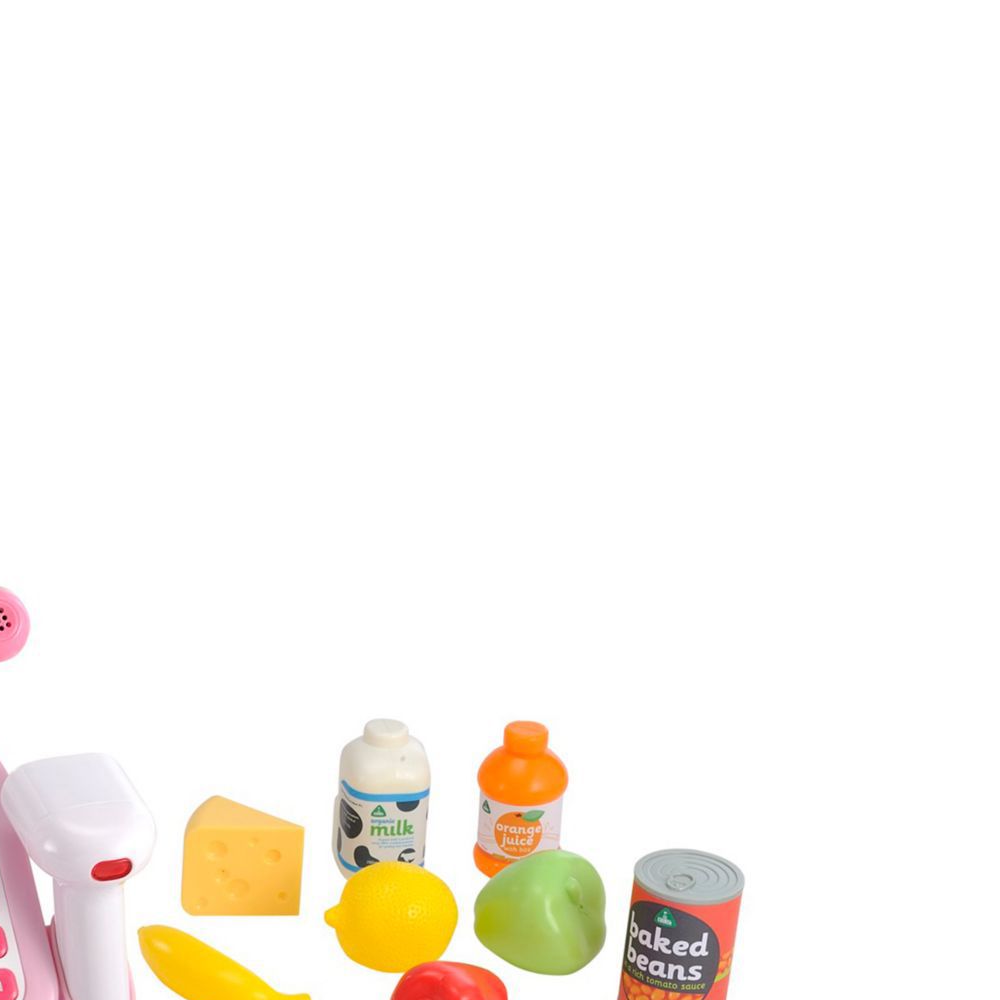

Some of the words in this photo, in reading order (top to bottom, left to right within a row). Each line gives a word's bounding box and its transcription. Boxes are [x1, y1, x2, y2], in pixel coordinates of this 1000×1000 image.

[370, 819, 414, 836] milk
[496, 823, 542, 838] orange
[500, 833, 534, 848] juice
[629, 910, 709, 957] baked
[627, 935, 703, 981] beans
[646, 976, 678, 990] tomato
[681, 982, 706, 990] sauce
